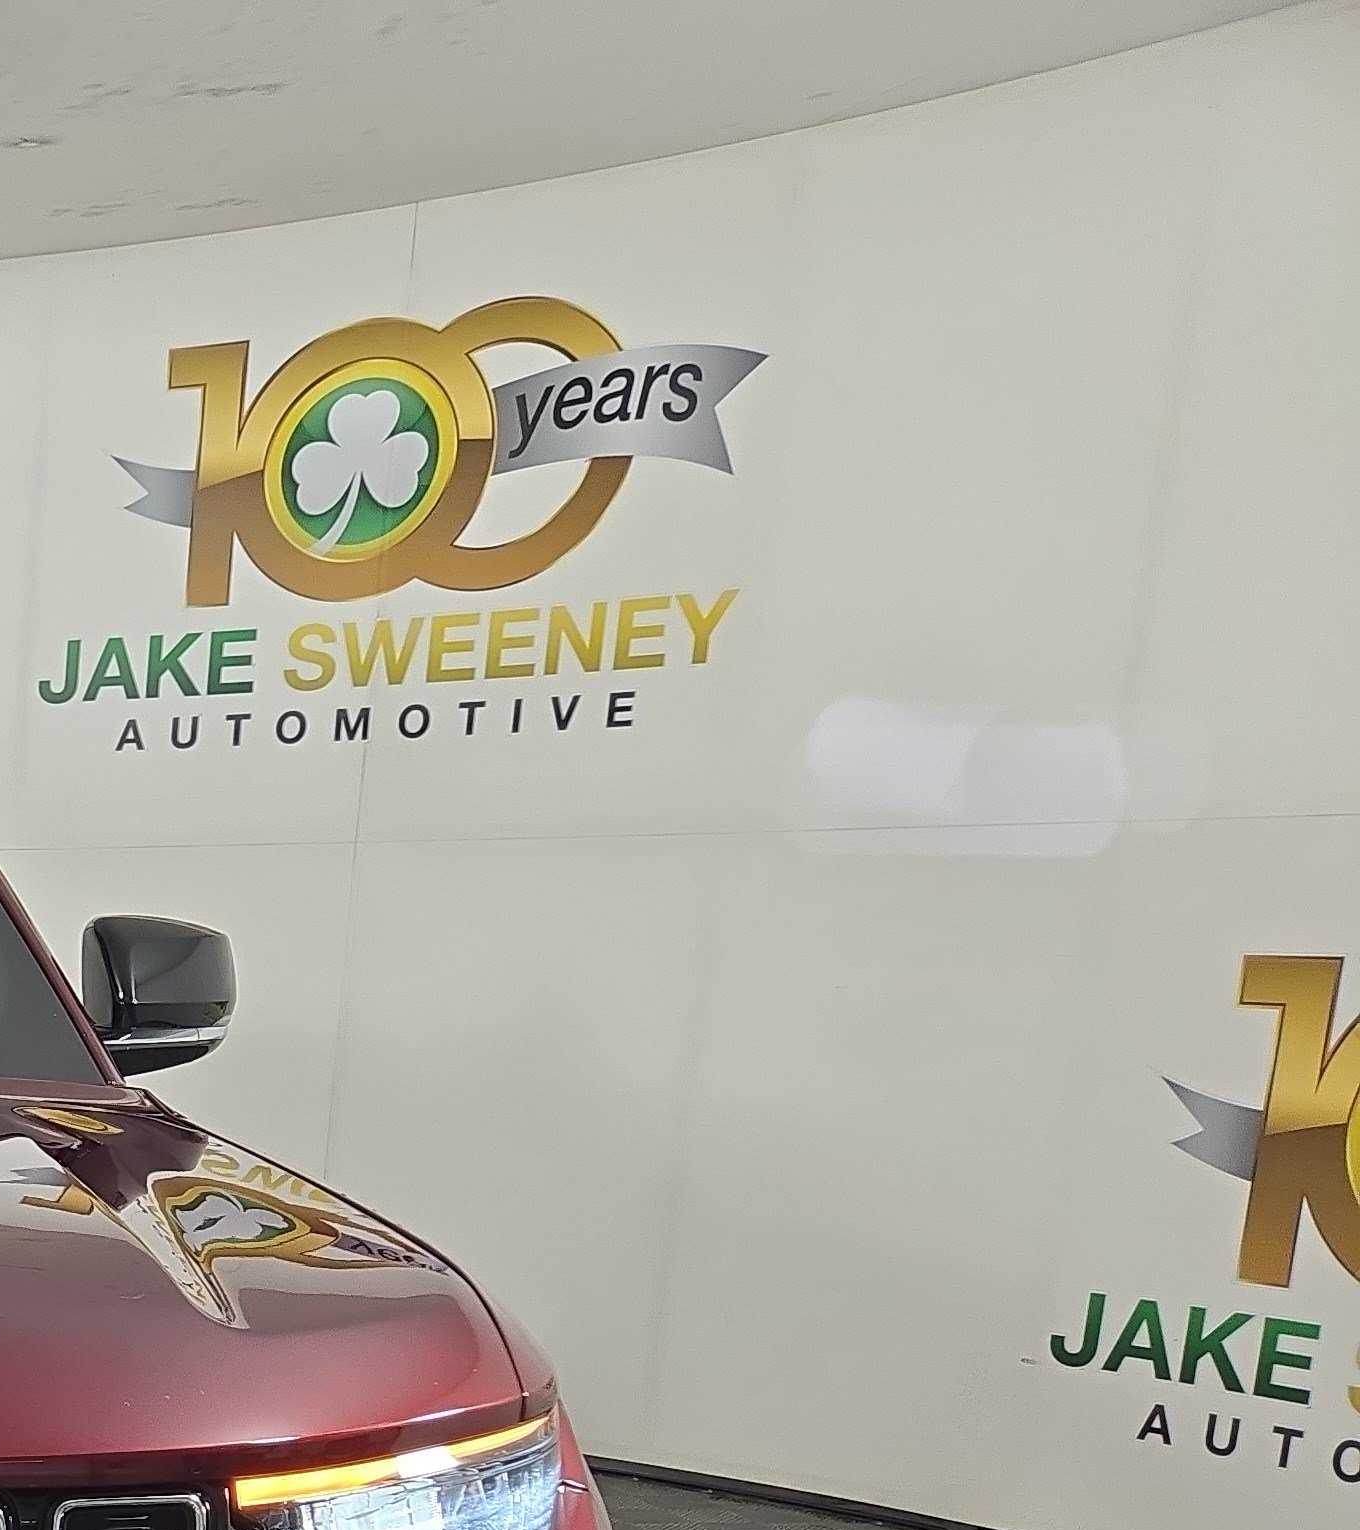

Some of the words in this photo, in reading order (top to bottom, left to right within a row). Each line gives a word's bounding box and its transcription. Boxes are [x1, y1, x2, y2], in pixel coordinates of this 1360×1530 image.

[167, 295, 632, 607] 100
[508, 362, 703, 459] years
[38, 629, 259, 706] JAKE
[282, 589, 740, 692] SWEENEY
[115, 691, 636, 752] AUTOMOTIVE
[1049, 1292, 1321, 1406] JAKE
